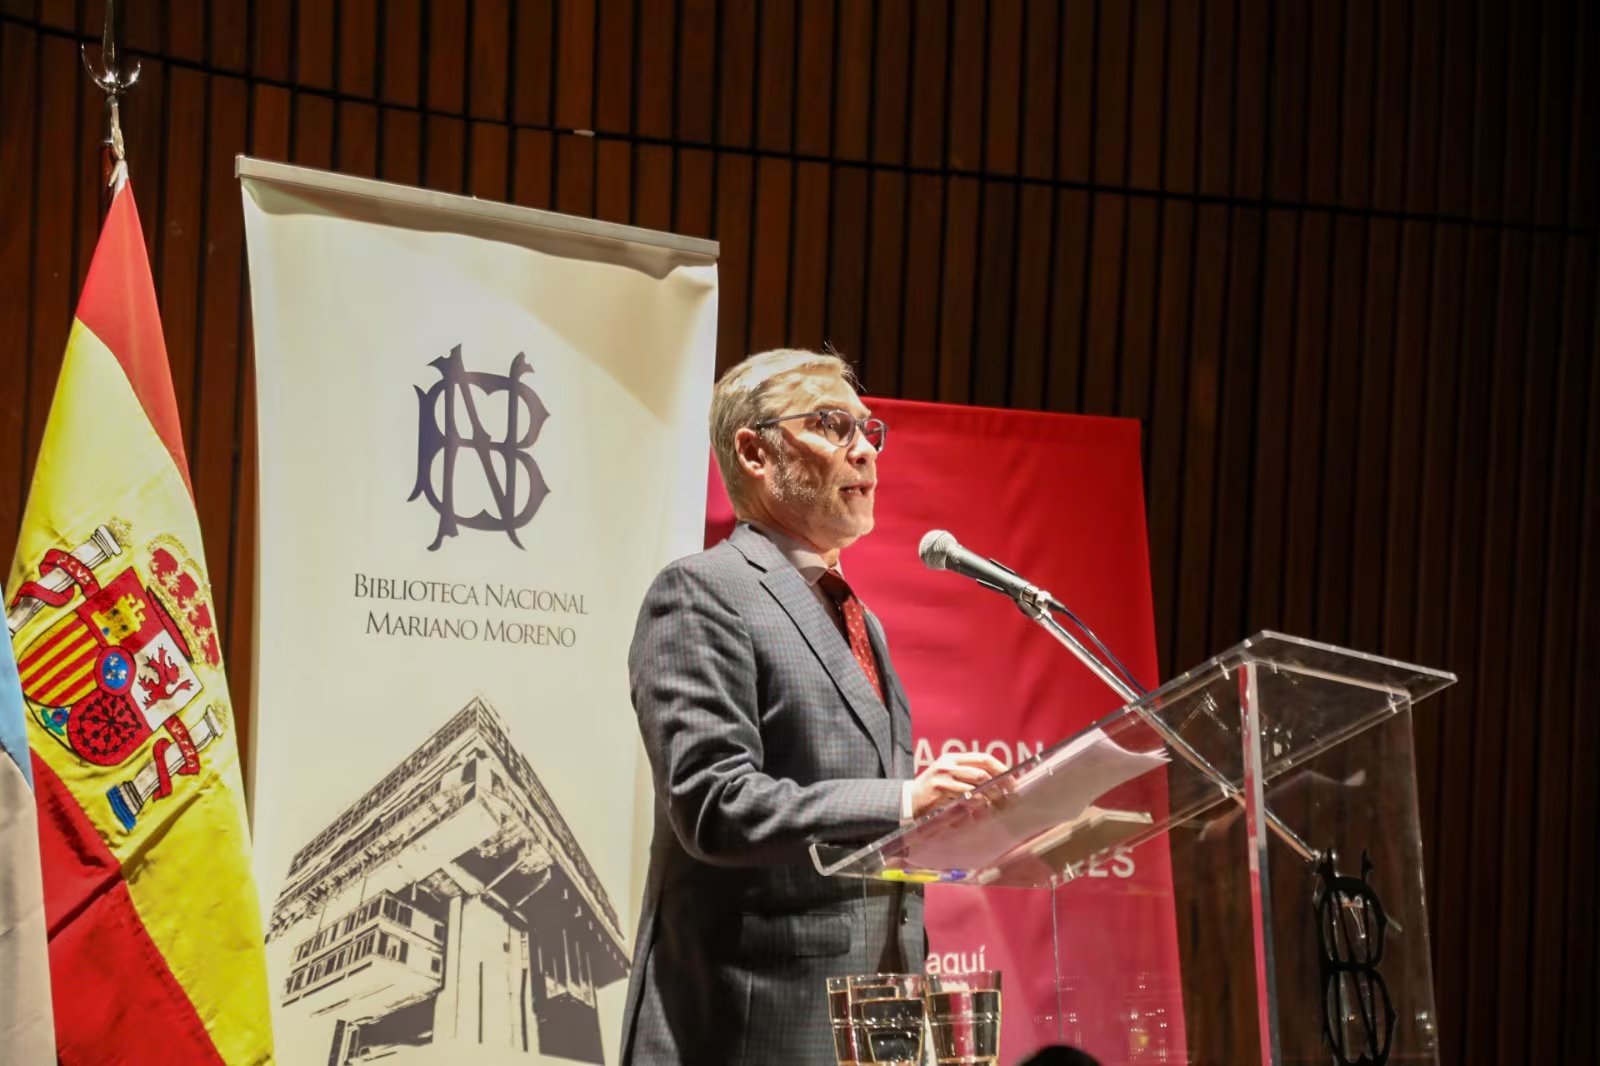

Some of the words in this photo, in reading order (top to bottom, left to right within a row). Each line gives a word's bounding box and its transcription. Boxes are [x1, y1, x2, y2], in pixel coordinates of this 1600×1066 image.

[354, 573, 479, 605] BIBLIOTECA
[485, 583, 589, 615] NACIONAL
[366, 610, 478, 640] MARIANO
[483, 618, 577, 648] MORENO
[926, 945, 986, 976] aquí
